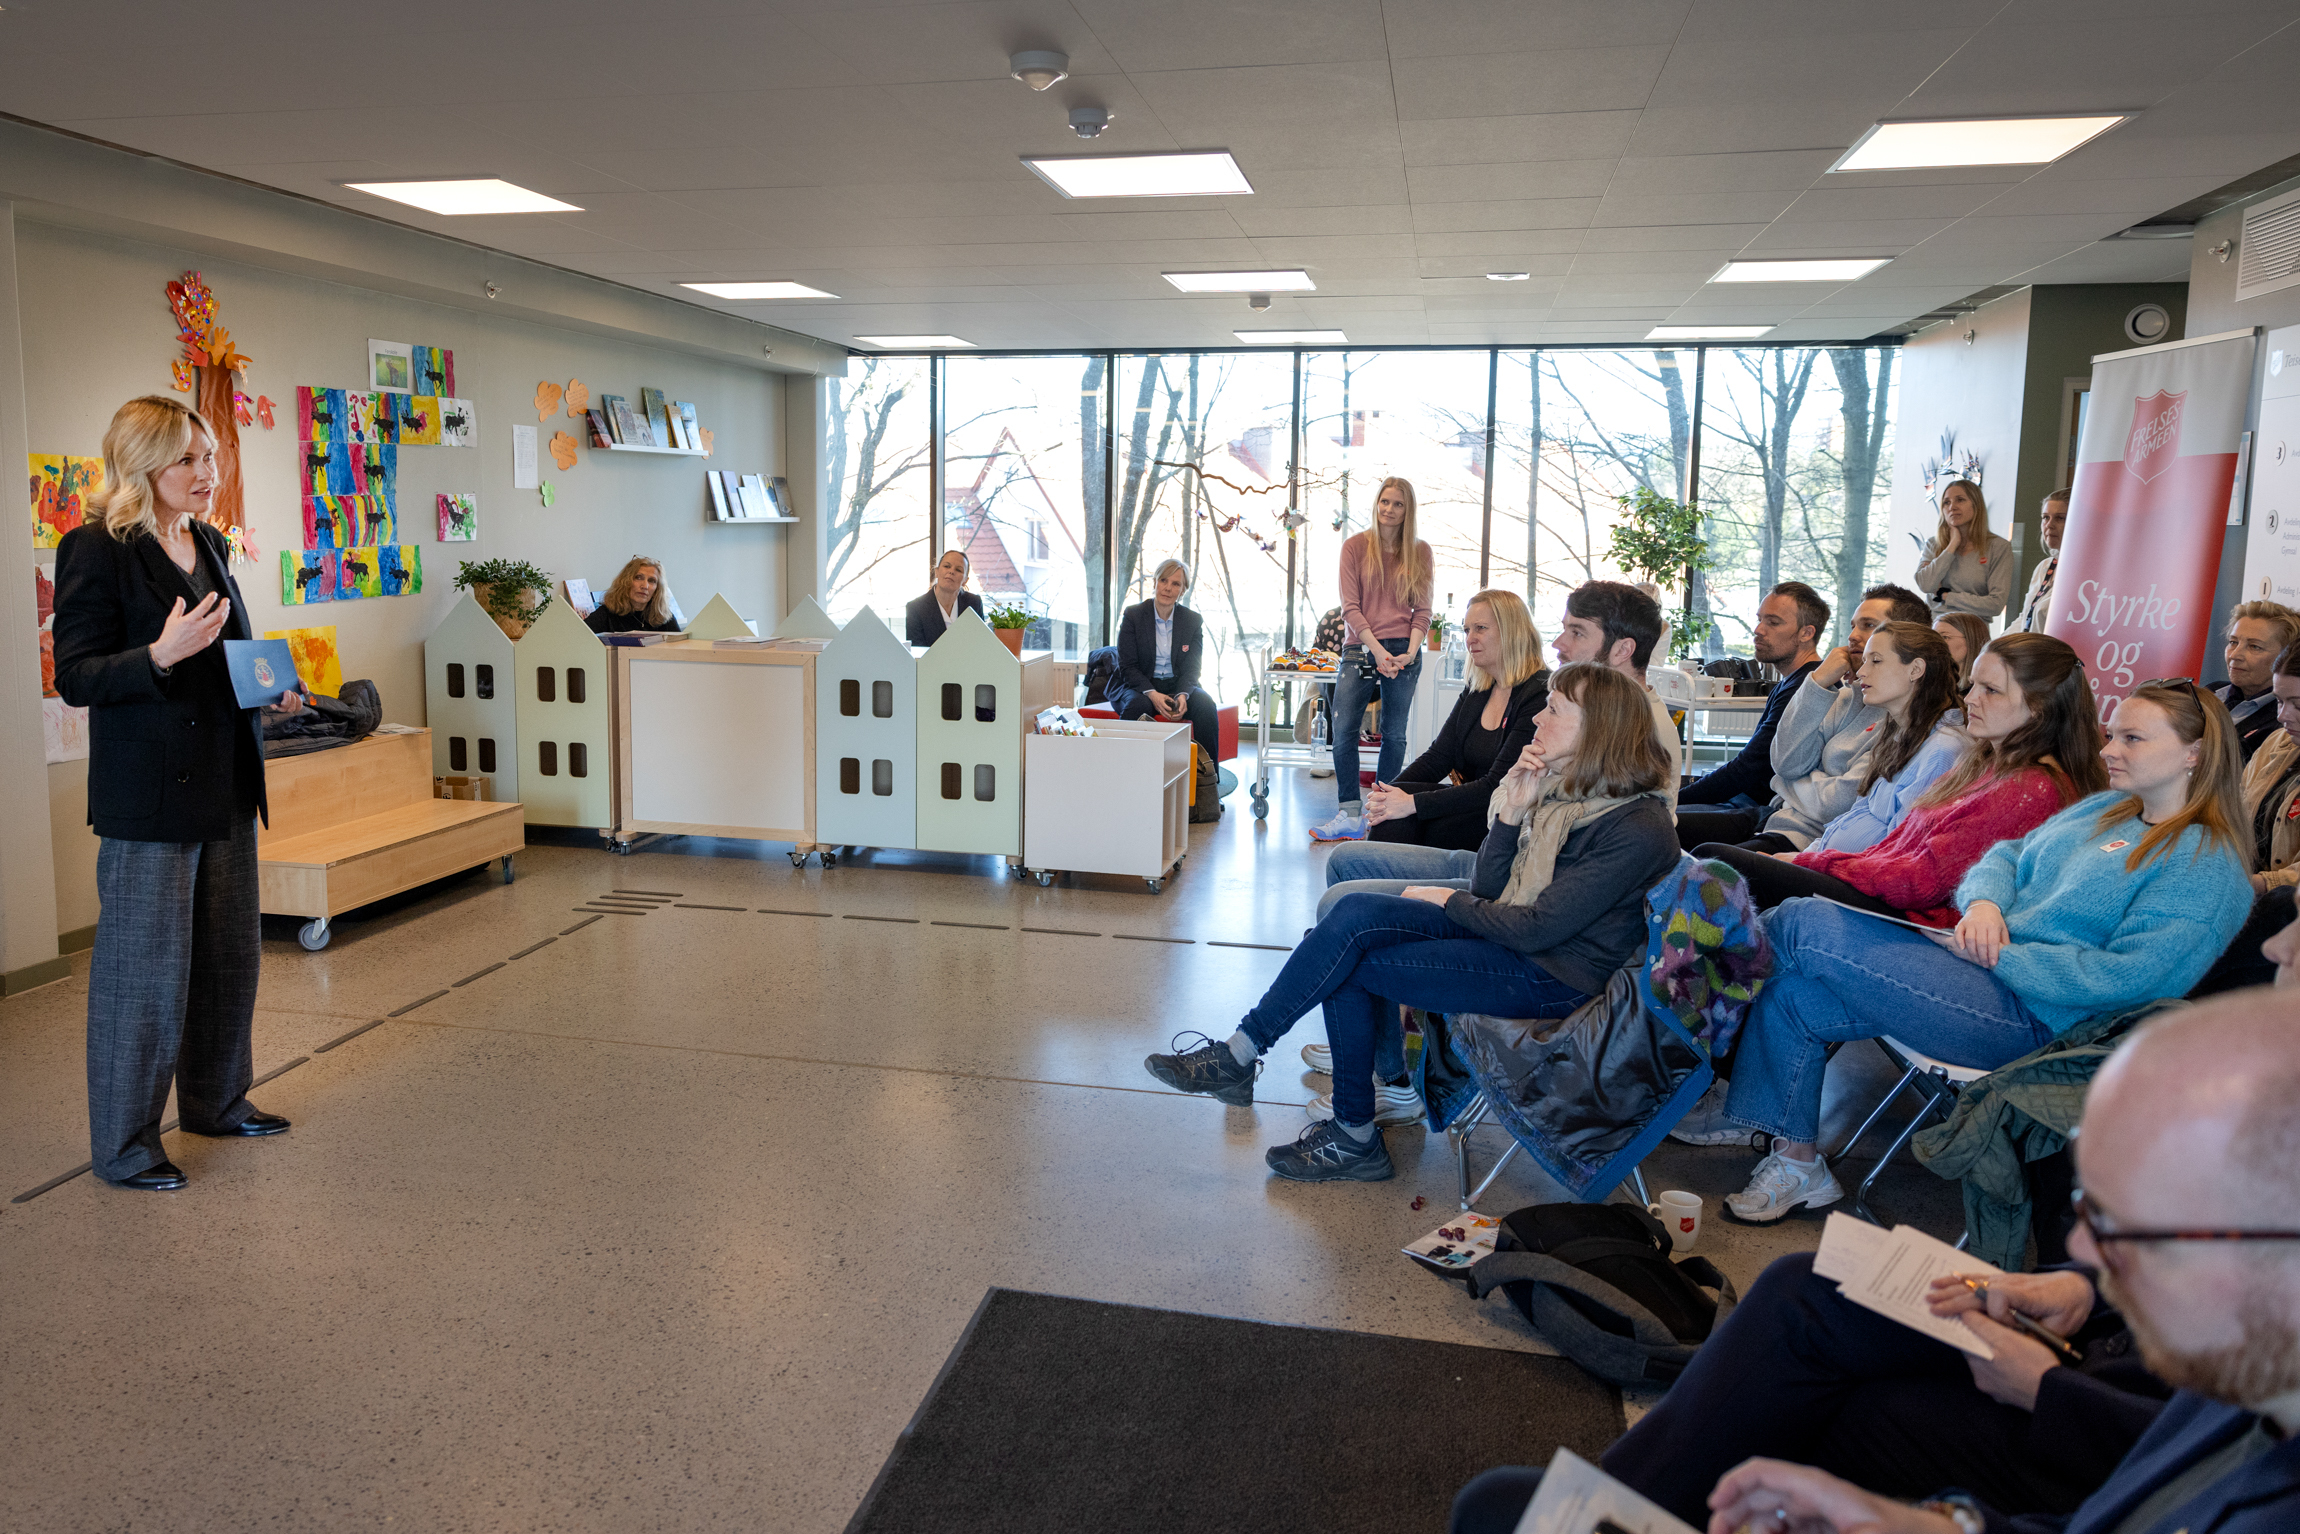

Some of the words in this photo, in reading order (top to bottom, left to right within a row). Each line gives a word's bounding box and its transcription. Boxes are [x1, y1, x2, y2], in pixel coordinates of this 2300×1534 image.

[2130, 400, 2181, 453] FRELSES-
[2131, 420, 2178, 467] ARMEEN
[2276, 446, 2282, 460] 3
[2269, 515, 2274, 528] 2
[2066, 579, 2181, 637] Styrke
[2096, 640, 2144, 687] og
